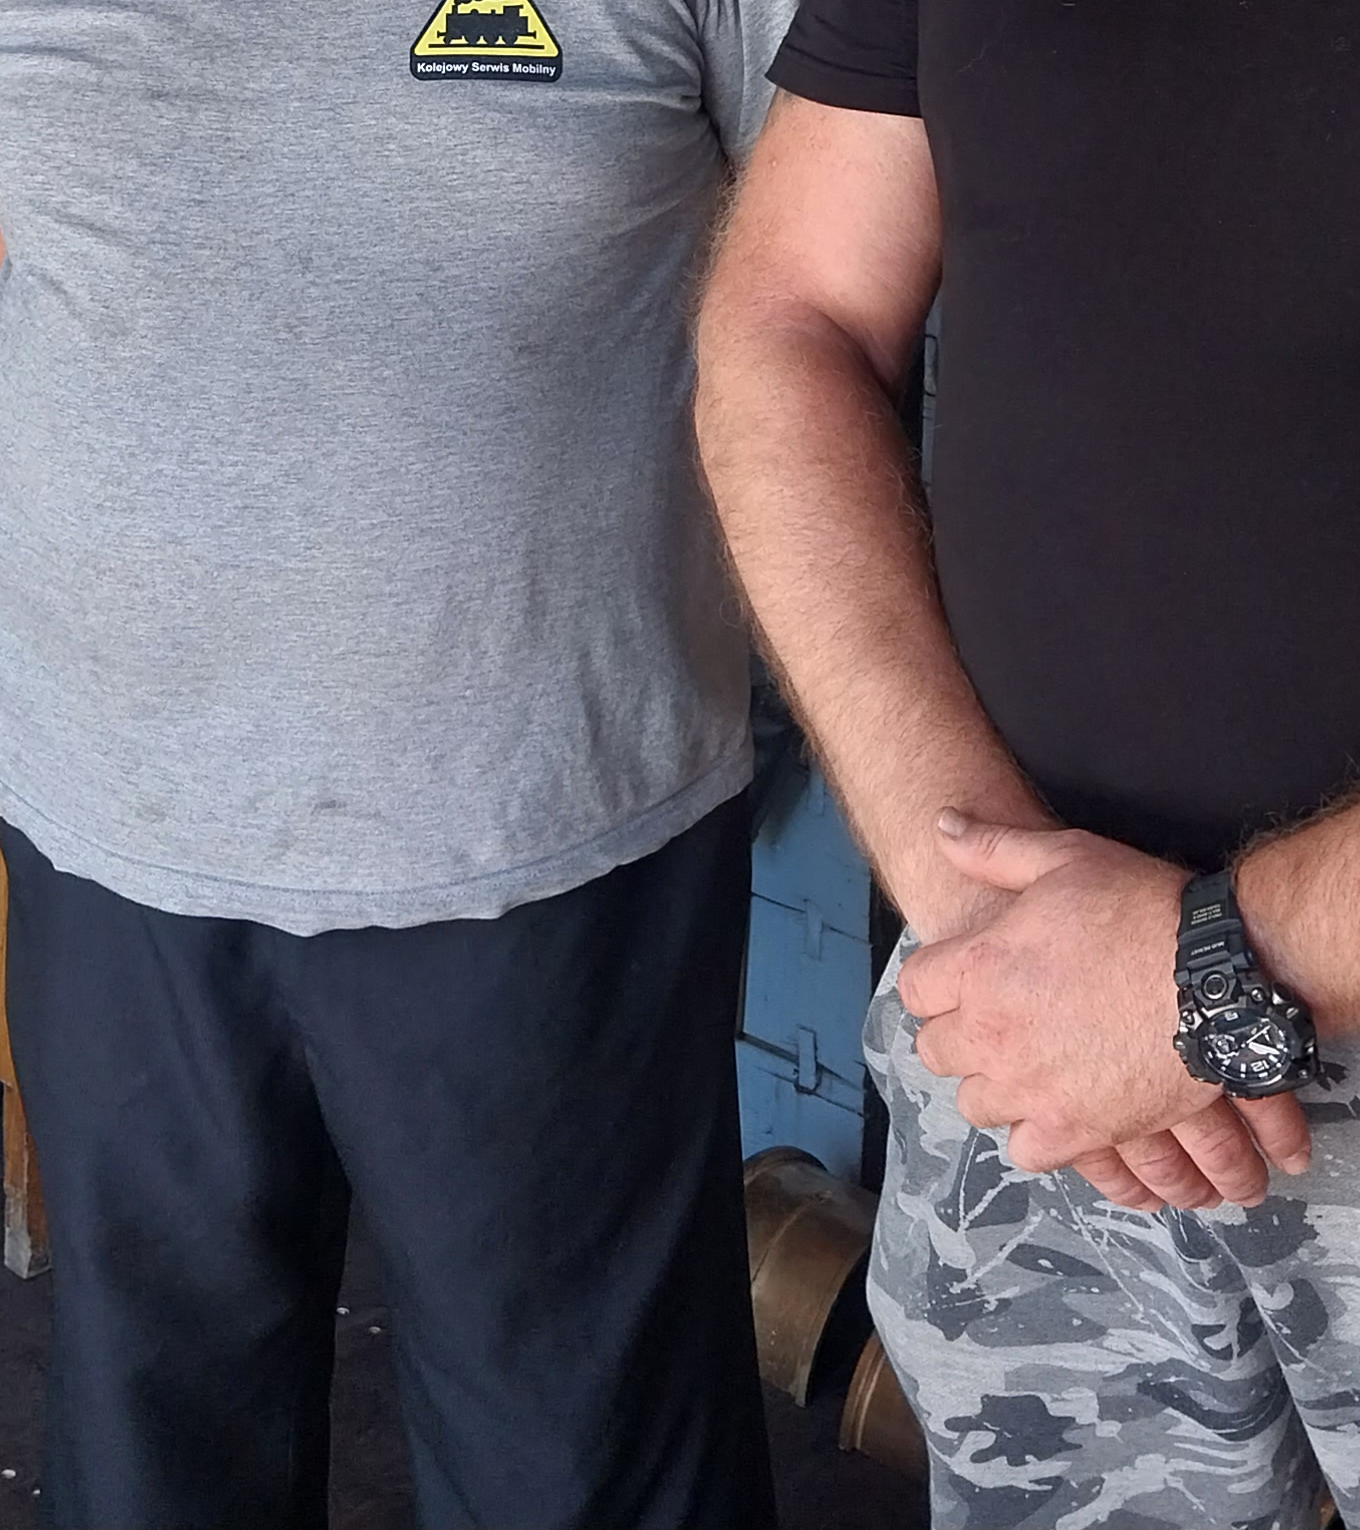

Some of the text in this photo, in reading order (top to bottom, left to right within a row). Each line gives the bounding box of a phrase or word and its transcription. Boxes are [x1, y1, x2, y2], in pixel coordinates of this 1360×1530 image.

[417, 61, 557, 77] Kolejowy Serwis Mobilny
